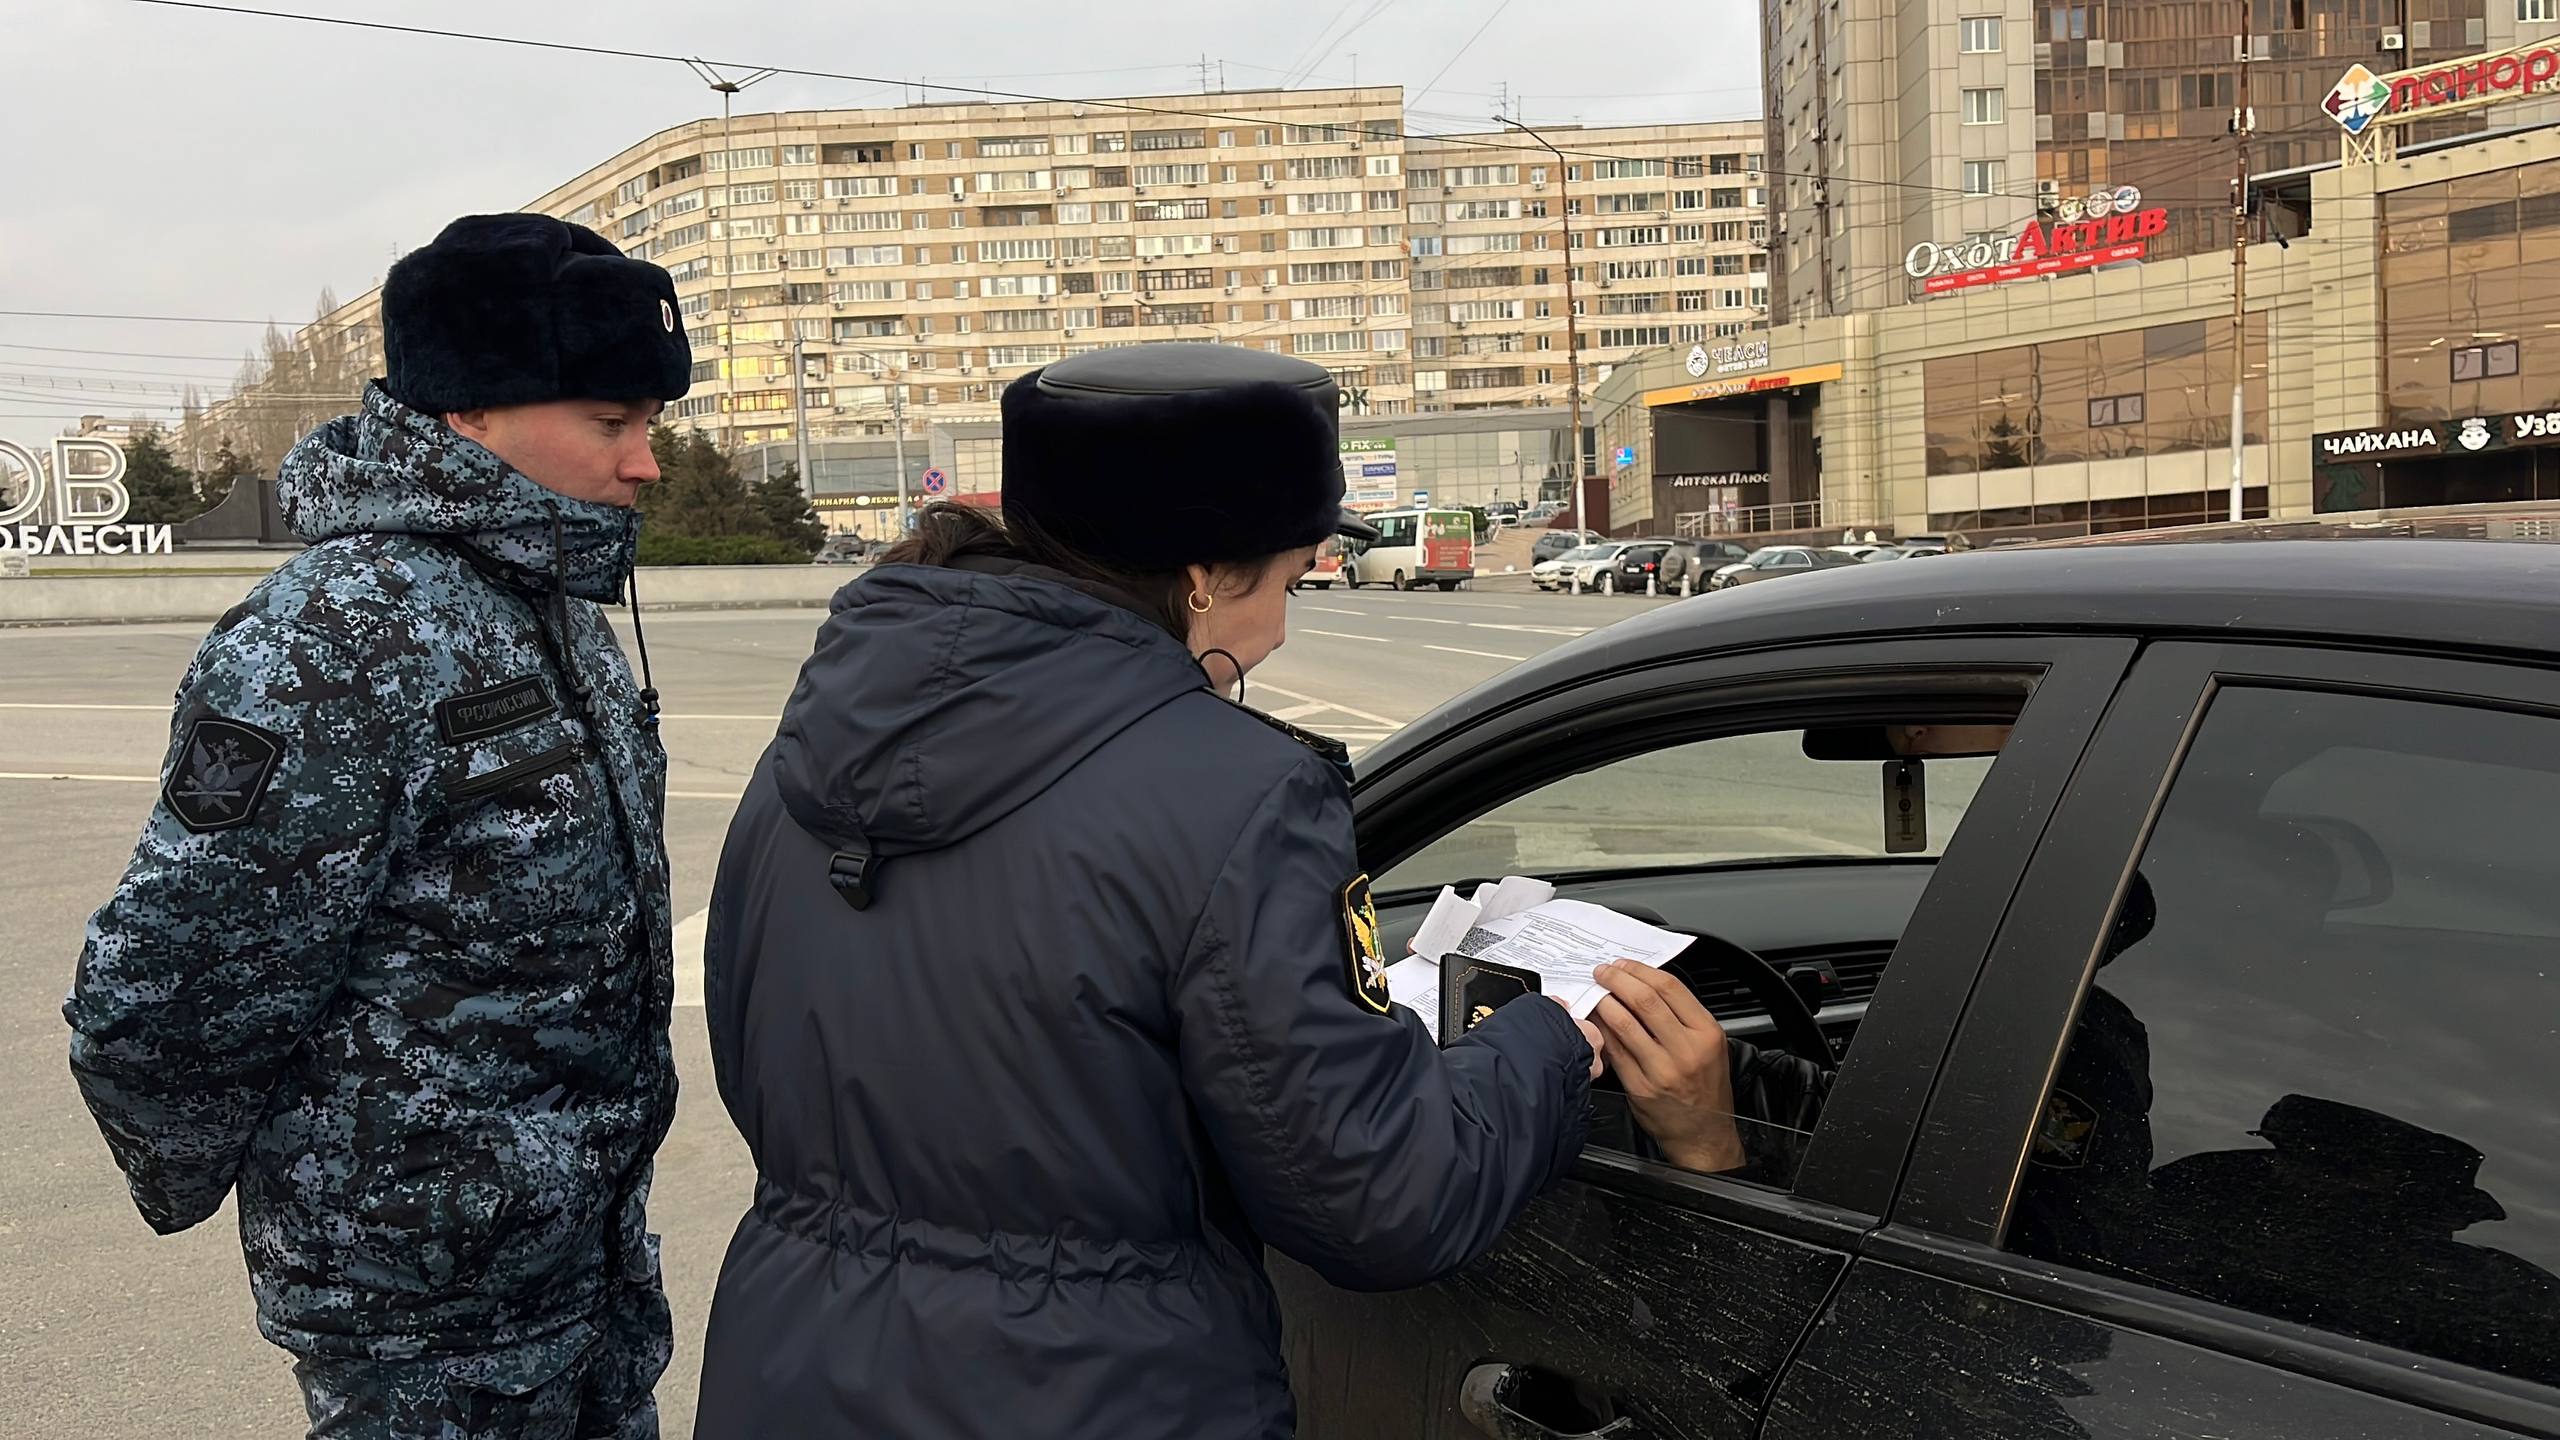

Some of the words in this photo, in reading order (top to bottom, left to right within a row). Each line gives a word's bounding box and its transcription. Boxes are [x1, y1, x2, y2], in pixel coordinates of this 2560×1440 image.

[2110, 246, 2140, 258] ОДЕЖДА
[1711, 340, 1769, 364] ЧЕЛСИ
[2323, 428, 2437, 455] ЧАЙХАНА
